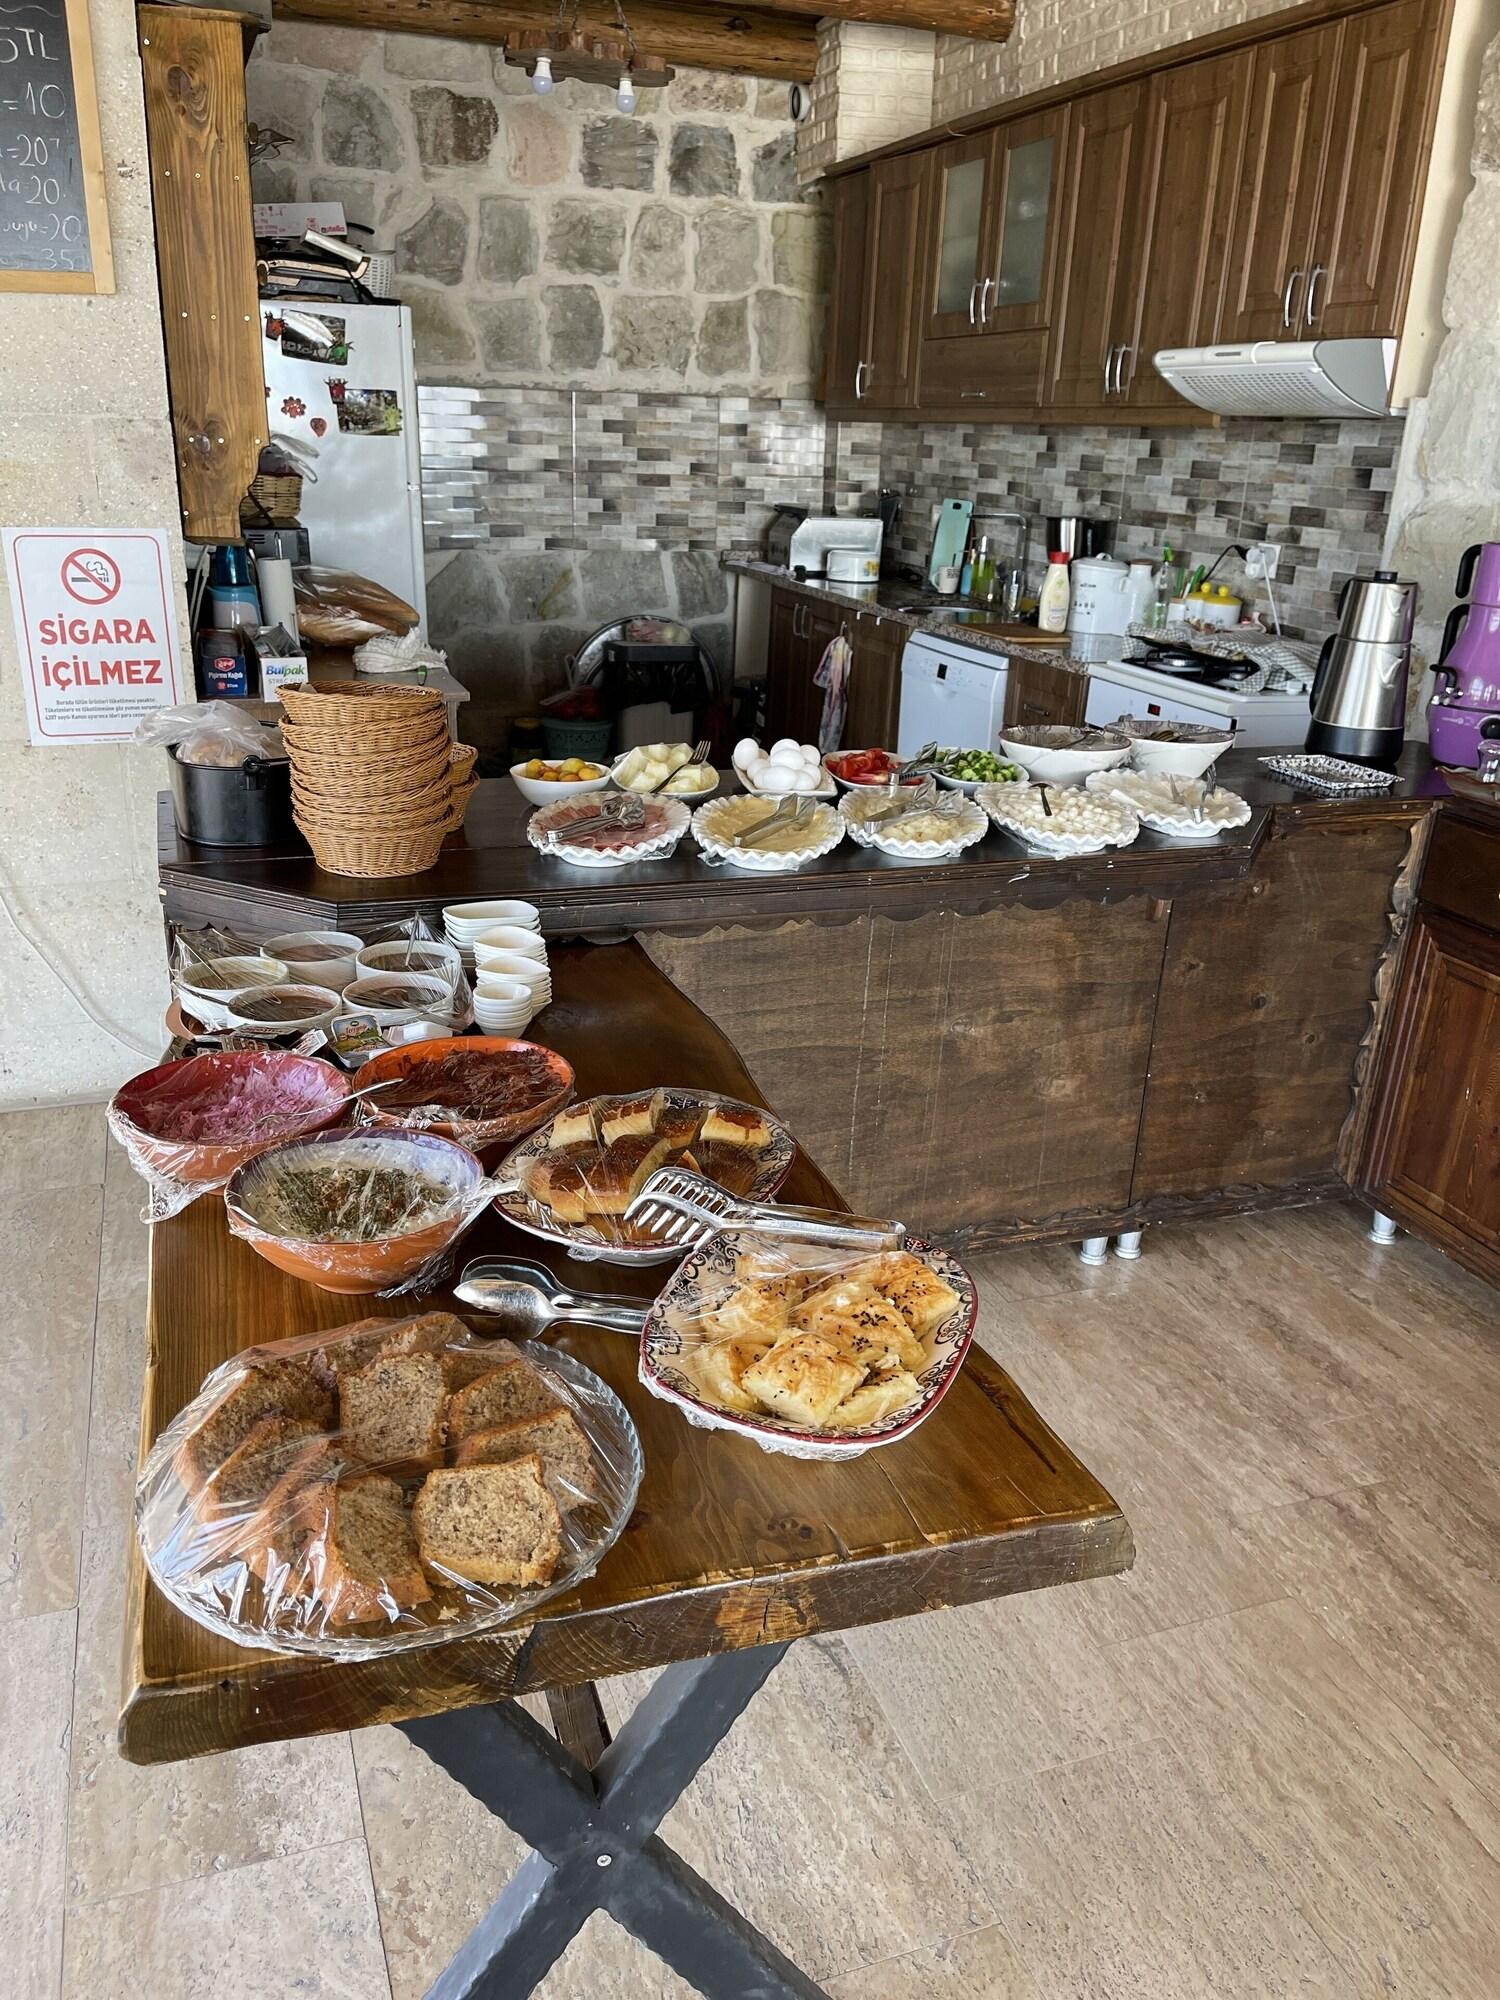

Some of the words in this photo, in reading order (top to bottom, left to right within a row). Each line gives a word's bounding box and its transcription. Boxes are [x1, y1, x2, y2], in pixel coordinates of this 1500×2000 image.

[39, 613, 156, 645] SİGARA
[41, 655, 163, 691] İÇİLMEZ
[266, 665, 305, 676] Bulpak
